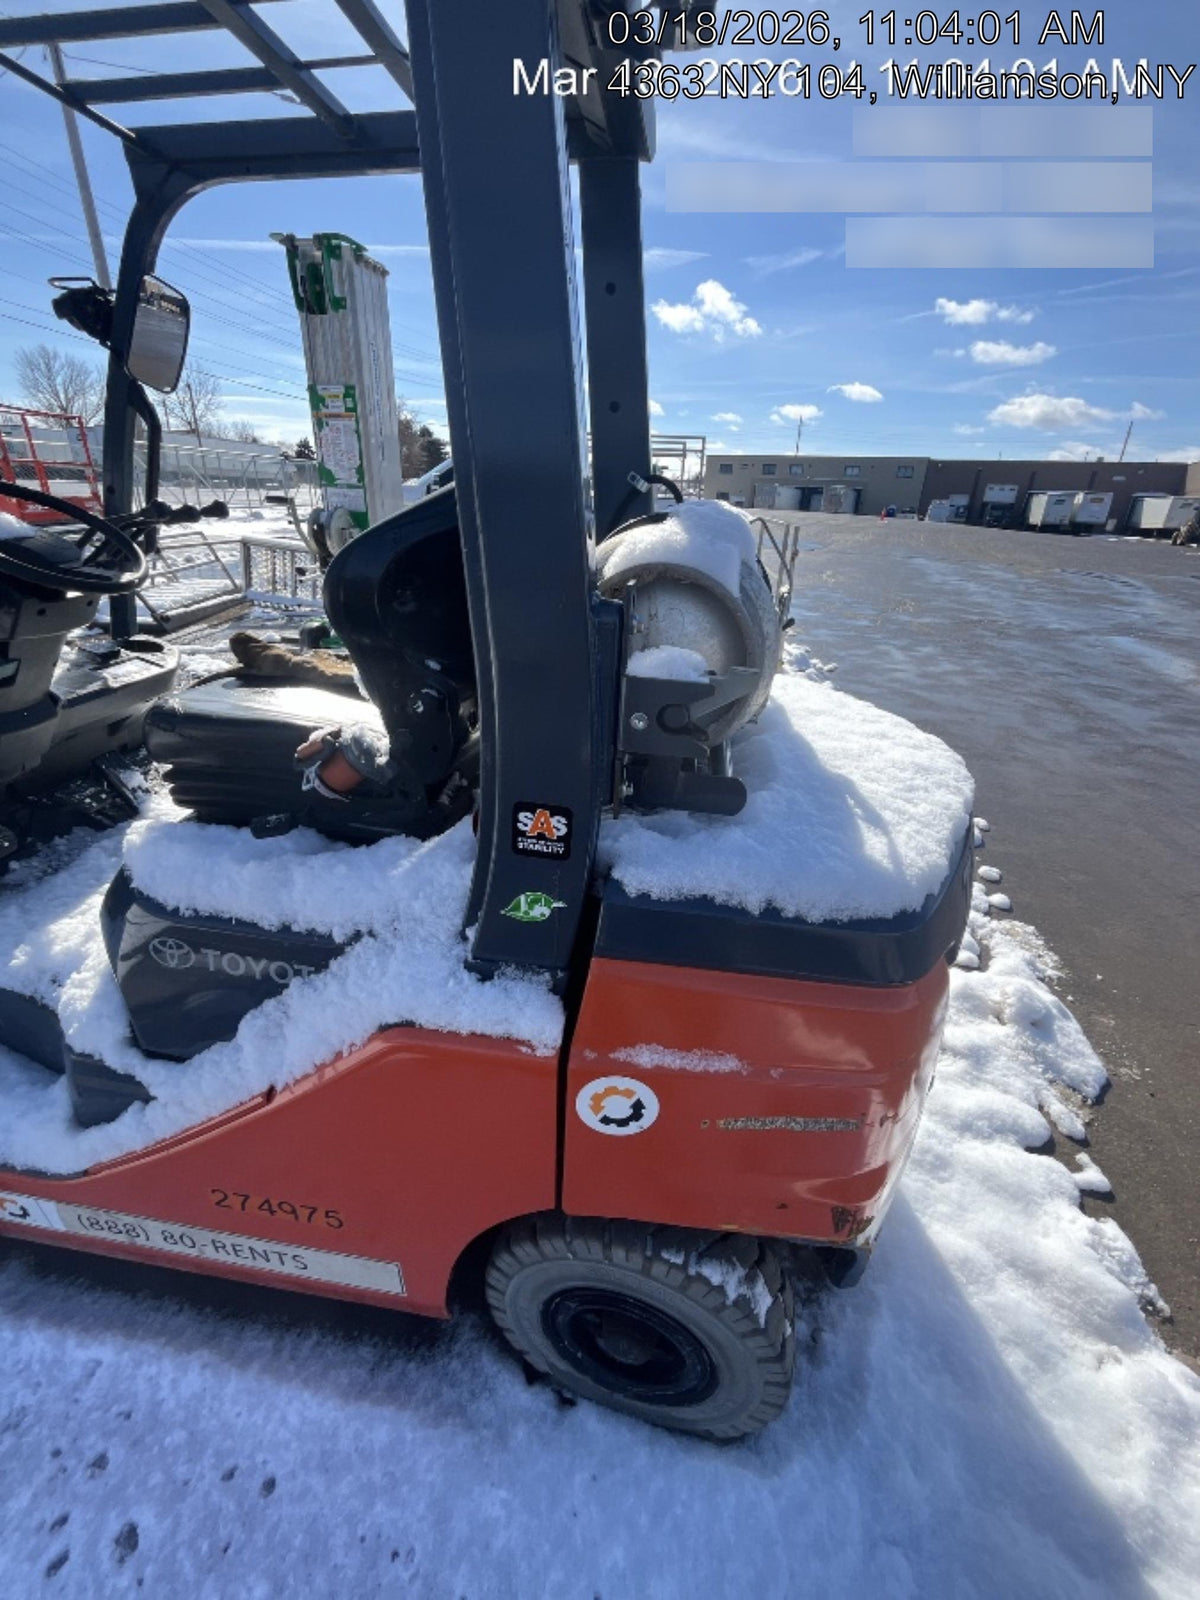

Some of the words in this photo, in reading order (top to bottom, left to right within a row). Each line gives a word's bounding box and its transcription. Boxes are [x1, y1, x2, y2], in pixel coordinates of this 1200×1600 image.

[516, 808, 568, 840] SAS
[200, 947, 315, 984] TOYOT
[211, 1188, 344, 1230] 274975
[77, 1213, 150, 1242] (888)
[161, 1229, 308, 1271] 80-RENTS
